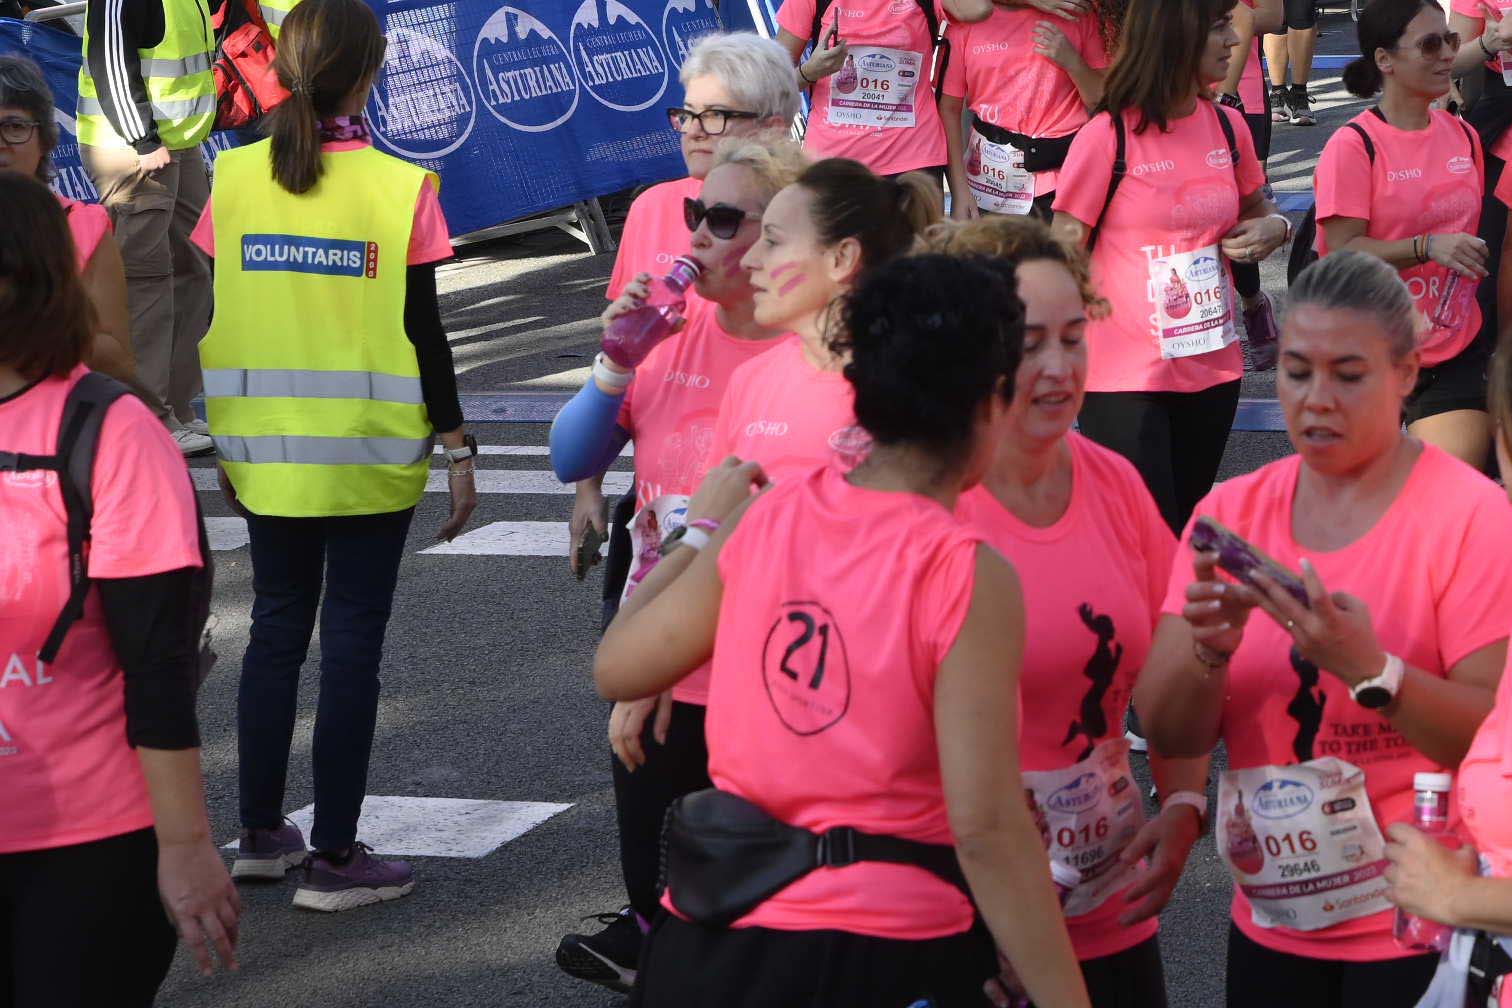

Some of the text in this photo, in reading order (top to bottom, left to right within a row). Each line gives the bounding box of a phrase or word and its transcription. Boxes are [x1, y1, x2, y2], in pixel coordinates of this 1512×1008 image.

[583, 41, 664, 87] ASTURIANA
[485, 58, 575, 107] ASTURIANA
[860, 77, 891, 91] 016
[861, 92, 885, 101] 20041
[979, 103, 999, 123] TU
[982, 164, 1005, 181] 016
[1132, 159, 1175, 177] OYSHO
[244, 244, 362, 268] VOLUNTARIS
[1194, 285, 1222, 305] 016
[1173, 323, 1203, 336] CARRERA
[779, 610, 830, 691] 21
[1319, 740, 1343, 755] TO
[1346, 738, 1377, 754] THE
[1057, 817, 1109, 848] 016
[1265, 830, 1318, 857] 016
